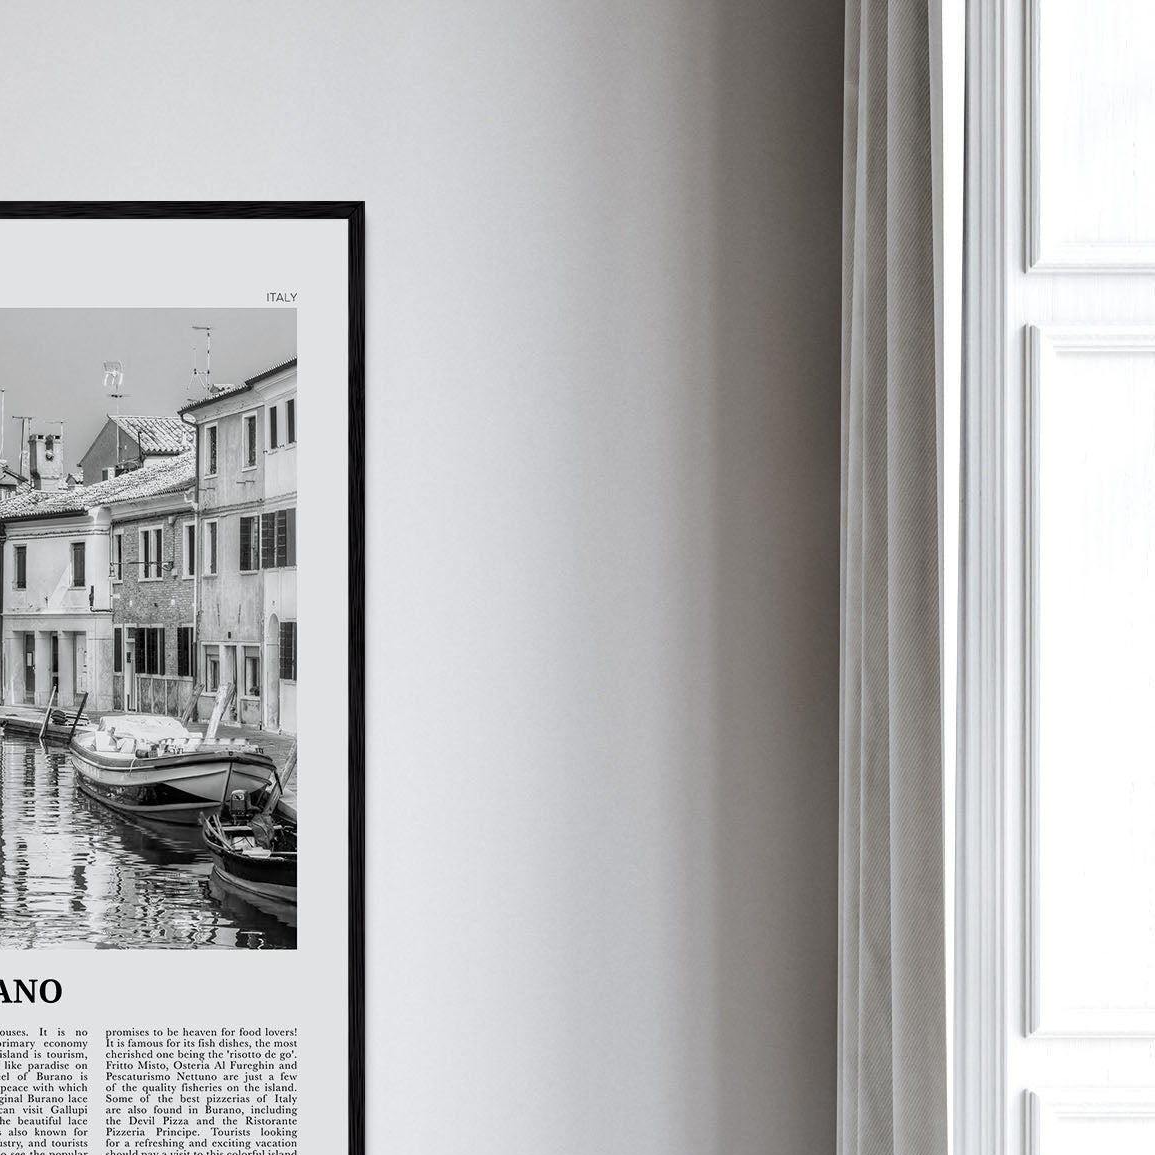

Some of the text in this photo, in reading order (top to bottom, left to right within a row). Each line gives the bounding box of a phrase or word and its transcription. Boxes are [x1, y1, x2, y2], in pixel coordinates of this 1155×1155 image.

[266, 292, 298, 302] ITALY
[39, 1028, 48, 1036] It
[57, 1028, 66, 1036] is
[105, 1028, 150, 1038] promises
[167, 1028, 180, 1036] be
[183, 1028, 217, 1036] heaven
[221, 1028, 236, 1036] for
[239, 1028, 262, 1036] food
[265, 1028, 297, 1036] lovers!
[0, 1050, 29, 1059] island
[34, 1050, 42, 1059] is
[47, 1050, 88, 1061] tourism,
[105, 1050, 153, 1059] cherished
[178, 1050, 206, 1061] being
[208, 1050, 224, 1059] the
[264, 1050, 277, 1059] de
[4, 1061, 22, 1070] like
[28, 1061, 70, 1072] paradise
[106, 1072, 171, 1081] Pescaturismo
[177, 1072, 218, 1081] Nettuno
[245, 1073, 263, 1083] just
[280, 1072, 298, 1081] few
[0, 1086, 29, 1094] peace
[32, 1083, 54, 1092] with
[58, 1083, 88, 1092] which
[105, 1083, 115, 1092] of
[121, 1083, 138, 1092] the
[142, 1083, 177, 1094] quality
[181, 1083, 223, 1092] fisheries
[244, 1083, 260, 1092] the
[264, 1083, 297, 1092] island.
[22, 1106, 43, 1114] visit
[50, 1106, 88, 1116] Gallupi
[127, 1106, 148, 1114] also
[153, 1106, 182, 1114] found
[188, 1106, 198, 1114] in
[205, 1106, 245, 1116] Burano,
[251, 1106, 298, 1116] including
[17, 1117, 62, 1125] beautiful
[68, 1117, 88, 1125] lace
[106, 1128, 298, 1138] Pizzeria Principe. Tourists looking
[28, 1139, 47, 1147] and
[51, 1139, 89, 1147] tourists
[106, 1139, 121, 1147] for
[135, 1139, 185, 1149] refreshing
[188, 1139, 208, 1147] and
[211, 1139, 252, 1149] exciting
[255, 1139, 297, 1147] vacation
